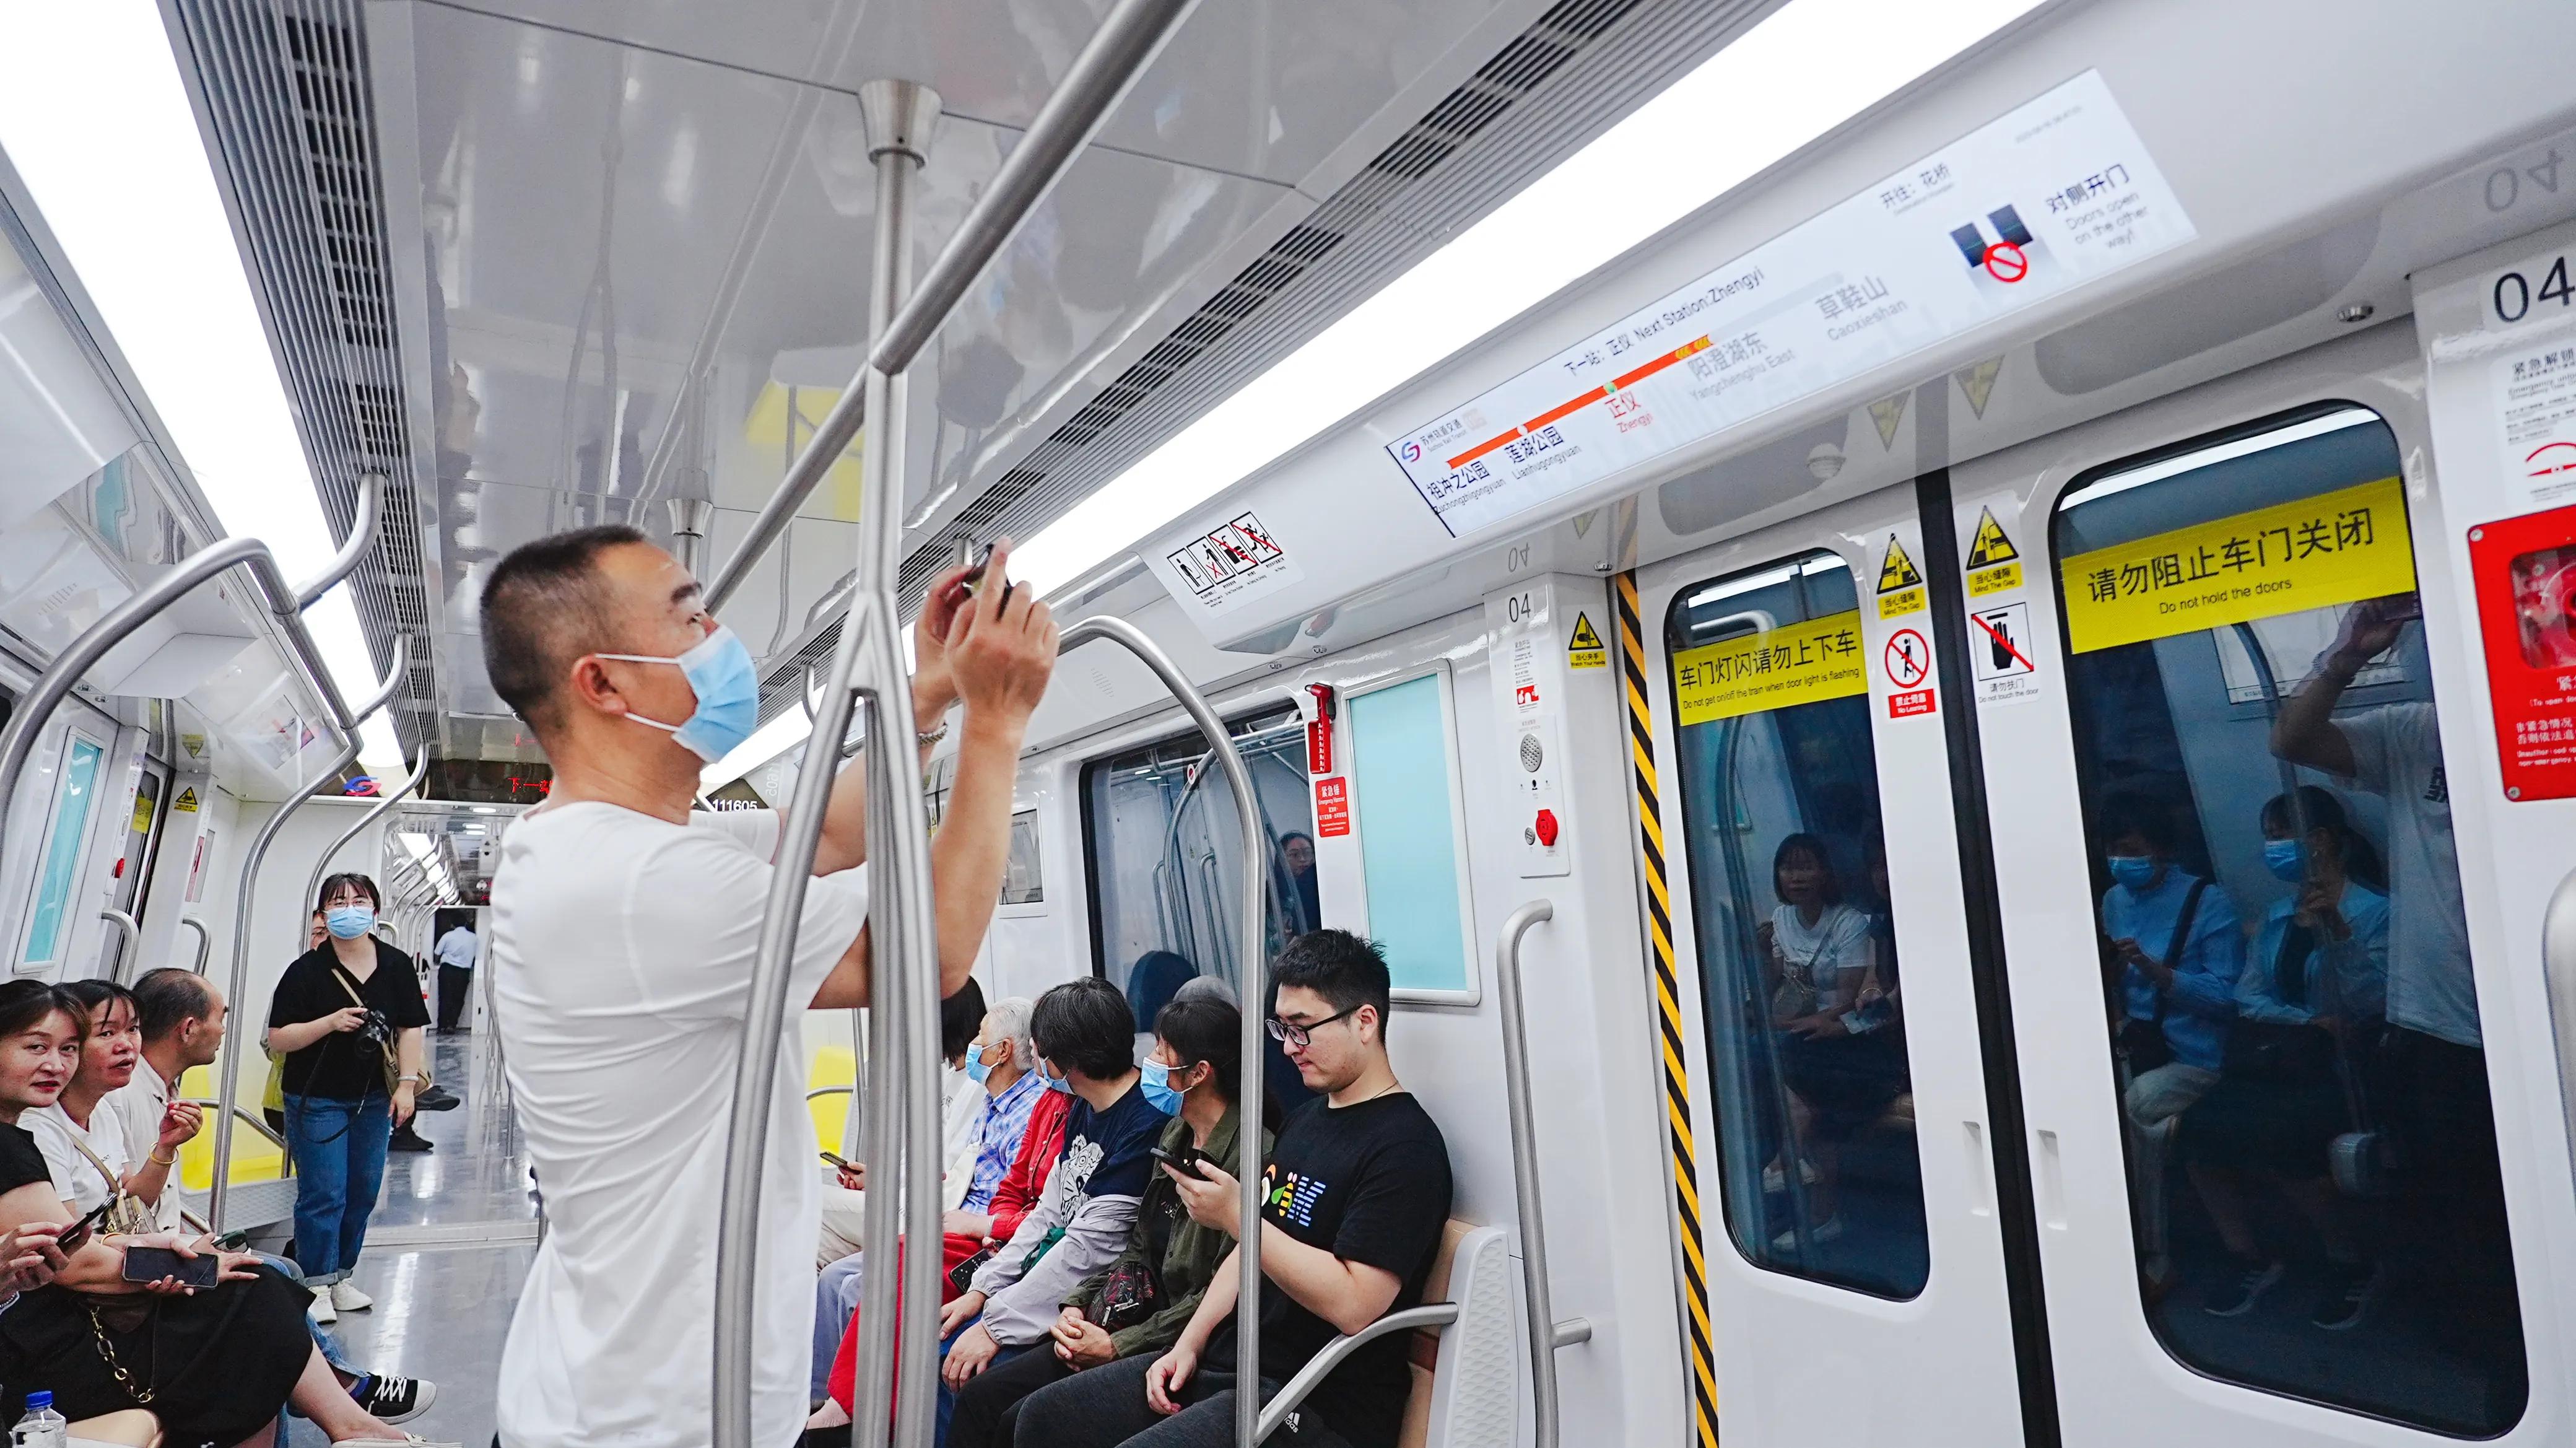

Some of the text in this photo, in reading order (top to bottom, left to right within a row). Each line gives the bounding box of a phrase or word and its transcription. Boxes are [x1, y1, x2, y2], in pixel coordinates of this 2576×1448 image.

[2045, 164, 2130, 214] 对侧开门
[2066, 193, 2139, 230] Doors open
[2075, 206, 2147, 245] on the other
[1814, 276, 1890, 320] 草鞋山
[2494, 256, 2576, 323] 04
[1633, 320, 1664, 341] Next
[1827, 300, 1908, 341] Caoxieshan
[1687, 332, 1768, 382] 阳澄湖东
[1689, 348, 1795, 401] Yangchenghu East
[1604, 391, 1642, 418] 正仪
[1616, 412, 1653, 434] Zhengyi
[1503, 426, 1564, 464] 莲湖公园
[1512, 445, 1582, 481] Lianhugongyuan
[1427, 461, 1490, 499] 祖冲之公园
[1431, 479, 1506, 515] Zuchongzhigongyuan
[2088, 507, 2374, 604] 请勿阻止车门关闭
[1509, 593, 1531, 623] 04
[1974, 585, 1989, 593] Mind
[2159, 579, 2292, 614] Do not hold the doors
[1680, 629, 1858, 690] 车门灯闪请勿上下车
[1683, 700, 1692, 709] Do
[1694, 699, 1704, 707] not
[1705, 696, 1715, 707] get
[1736, 689, 1747, 698] the
[1748, 687, 1764, 696] train
[1765, 683, 1784, 692] when
[1786, 678, 1802, 688] door
[1804, 674, 1820, 687] light
[1821, 673, 1828, 682] is
[1829, 668, 1860, 680] flashing
[2517, 729, 2576, 745] 否则依法追
[712, 798, 758, 812] 111605
